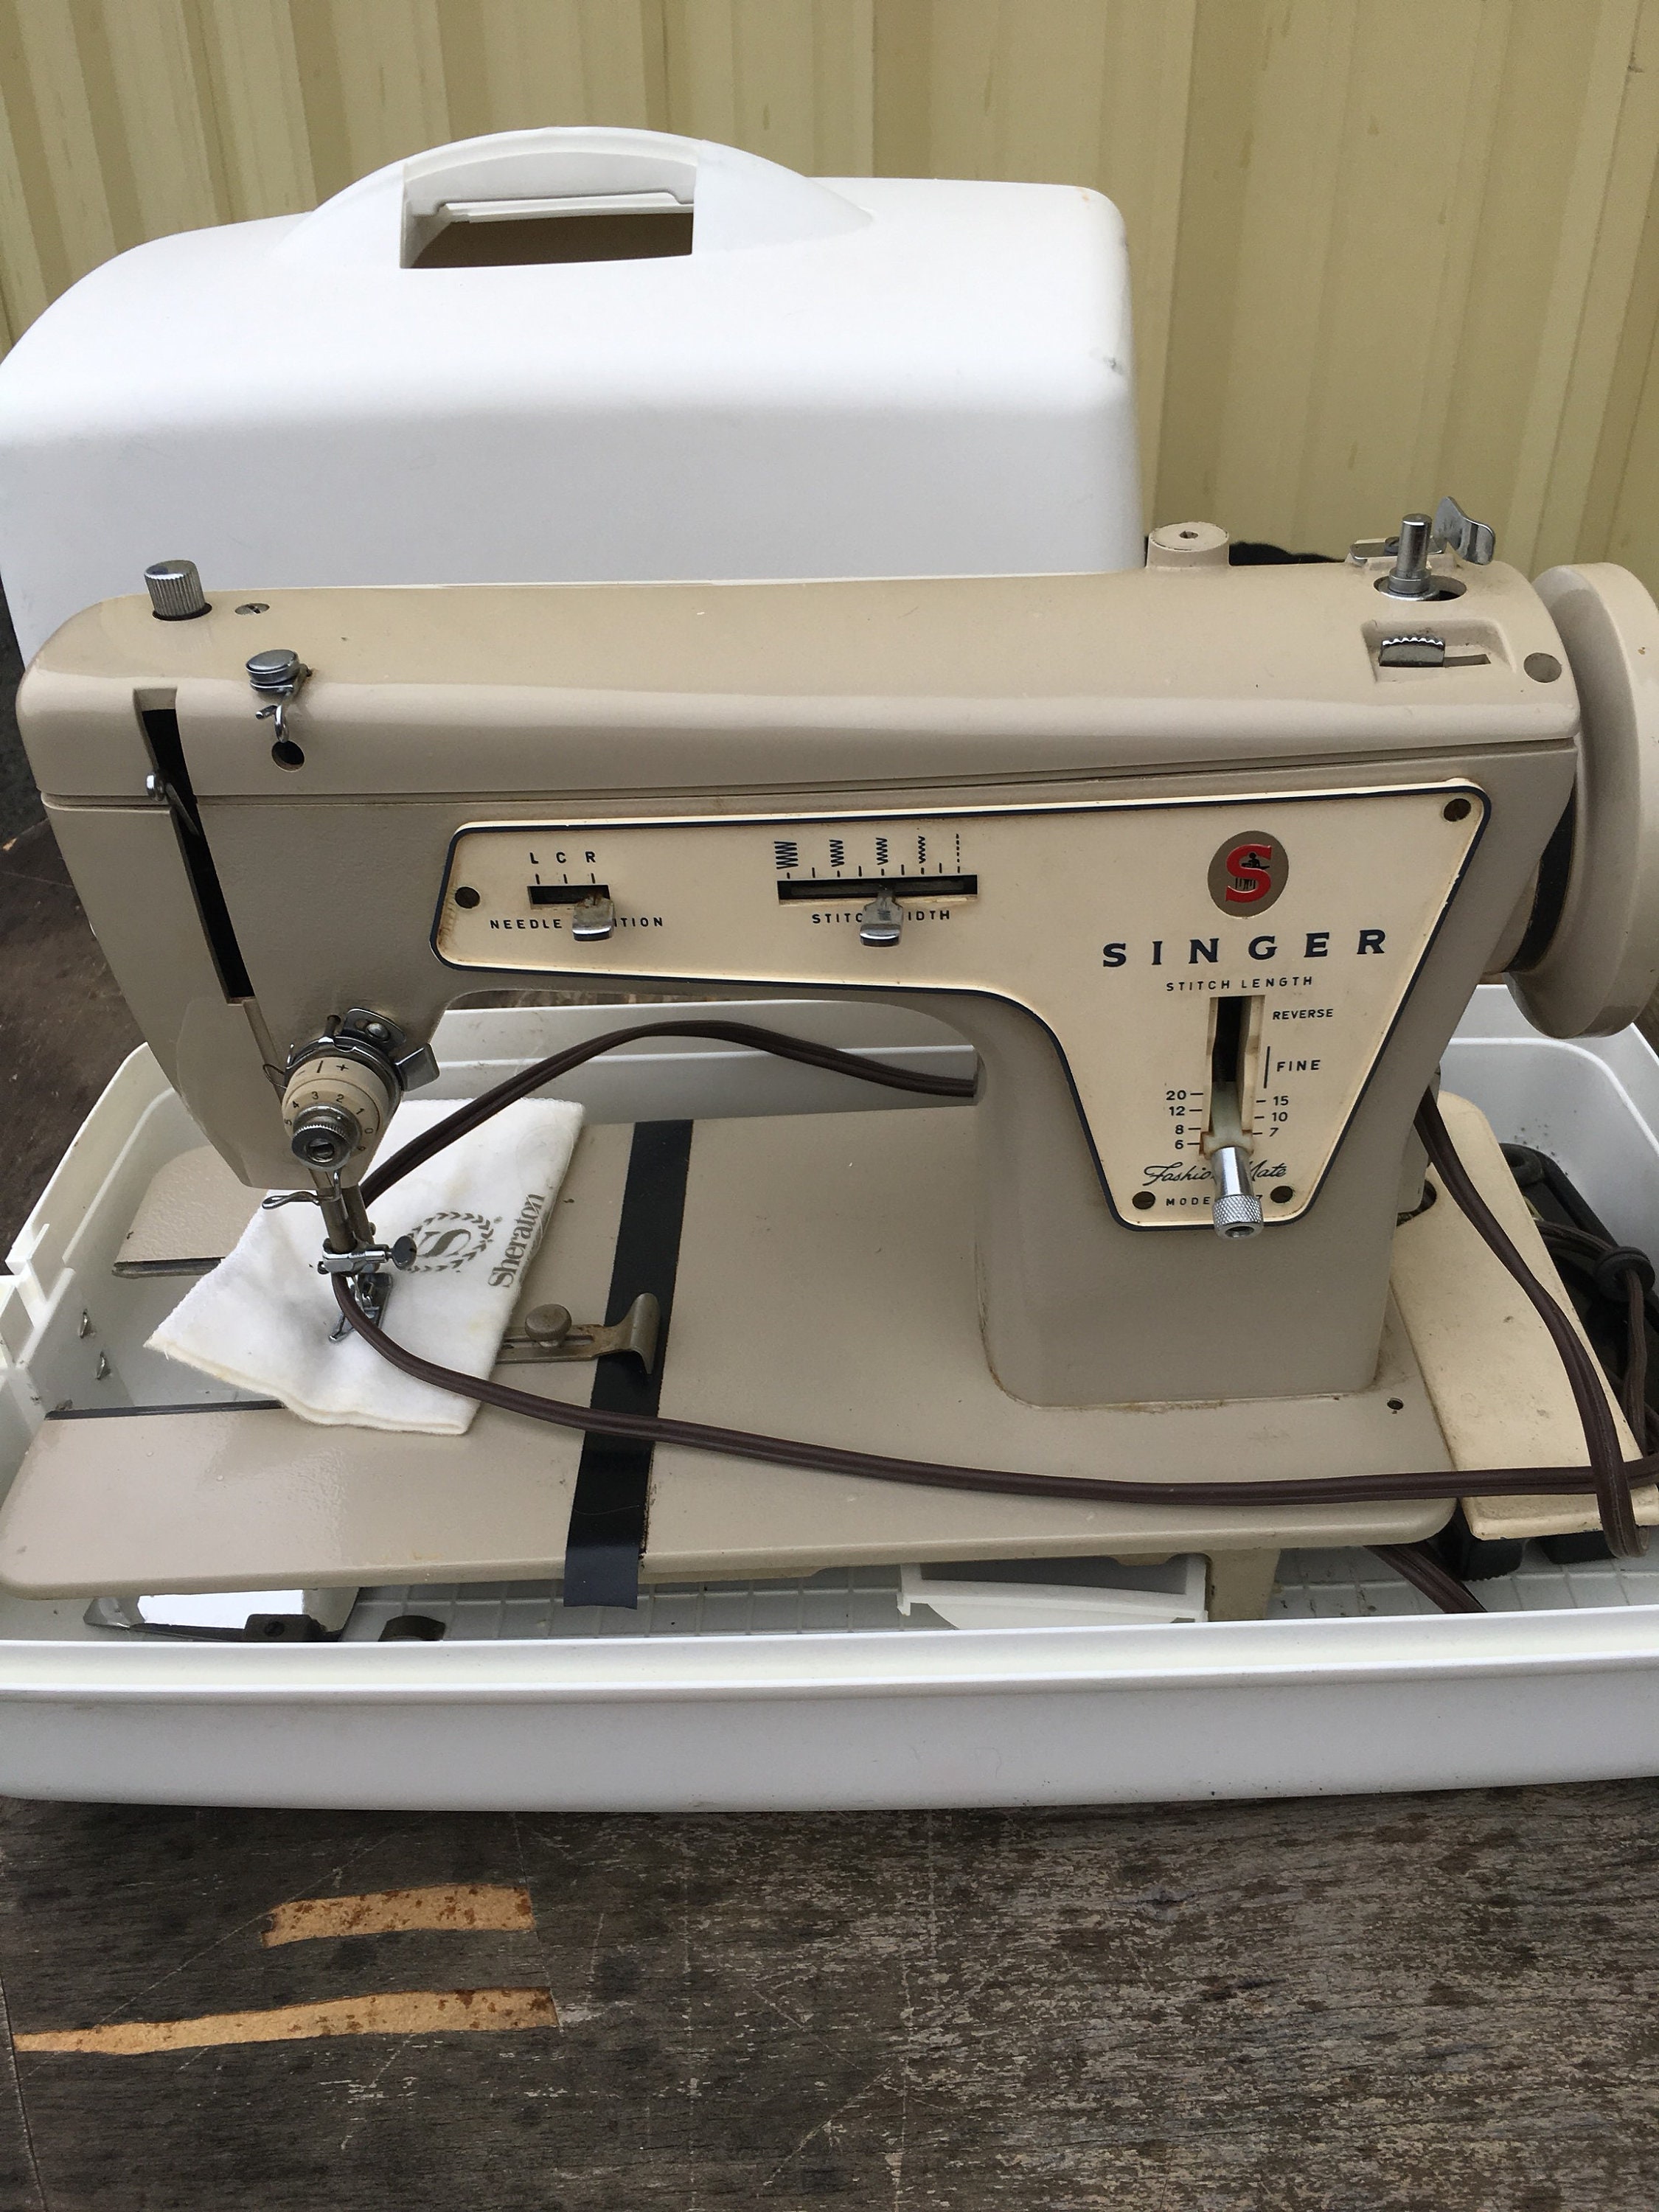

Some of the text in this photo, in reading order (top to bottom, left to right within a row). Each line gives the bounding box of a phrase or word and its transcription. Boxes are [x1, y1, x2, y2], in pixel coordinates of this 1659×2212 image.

[529, 851, 596, 864] L C R
[812, 910, 950, 924] STITC IDTH
[490, 919, 563, 929] NEEDLE
[1102, 929, 1386, 967] SINGER
[1166, 976, 1312, 991] STITCH LENGTH
[1272, 1008, 1334, 1020] REVERSE
[1276, 1060, 1321, 1072] FINE
[311, 1091, 319, 1100] 3
[335, 1094, 345, 1103] 2
[1166, 1090, 1187, 1101] 20
[1273, 1095, 1289, 1106] 15
[1169, 1105, 1186, 1116] 12
[1272, 1111, 1288, 1122] 10
[1175, 1124, 1184, 1135] 8
[1269, 1127, 1279, 1137] 7
[1175, 1139, 1184, 1150] 6
[1143, 1161, 1214, 1186] Fashio
[1166, 1196, 1211, 1206] MODE
[487, 1193, 546, 1288] Sheraton
